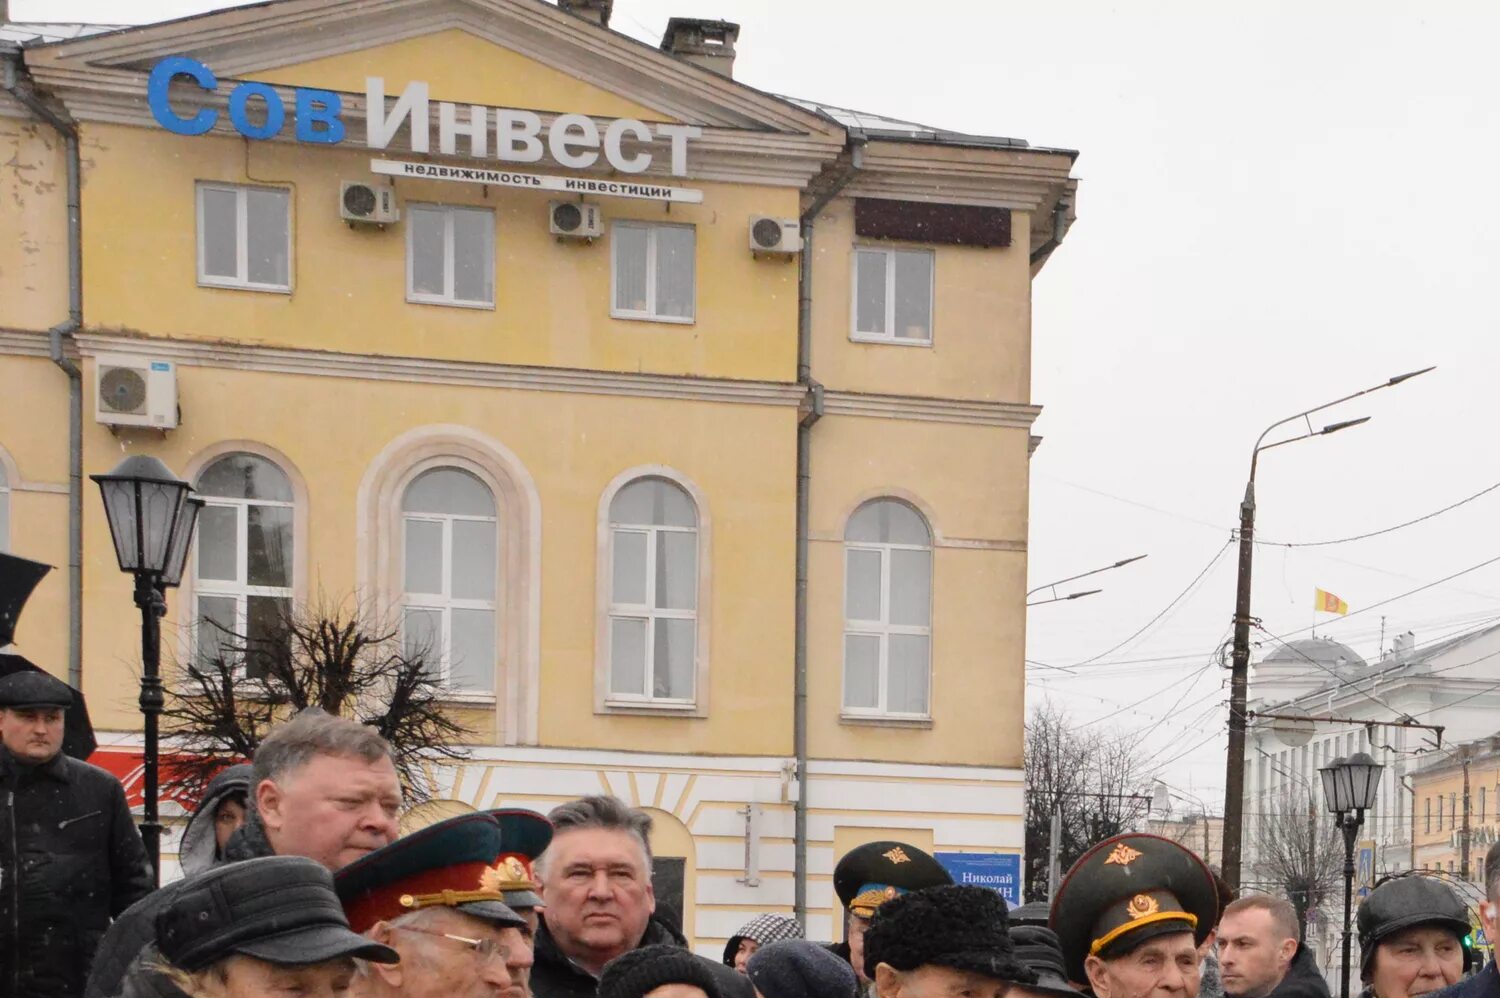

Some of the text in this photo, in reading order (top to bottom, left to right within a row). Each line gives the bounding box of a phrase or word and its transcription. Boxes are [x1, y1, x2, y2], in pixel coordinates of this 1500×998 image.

[404, 163, 673, 198] недвижимость инвестиции
[962, 872, 1013, 884] Николай
